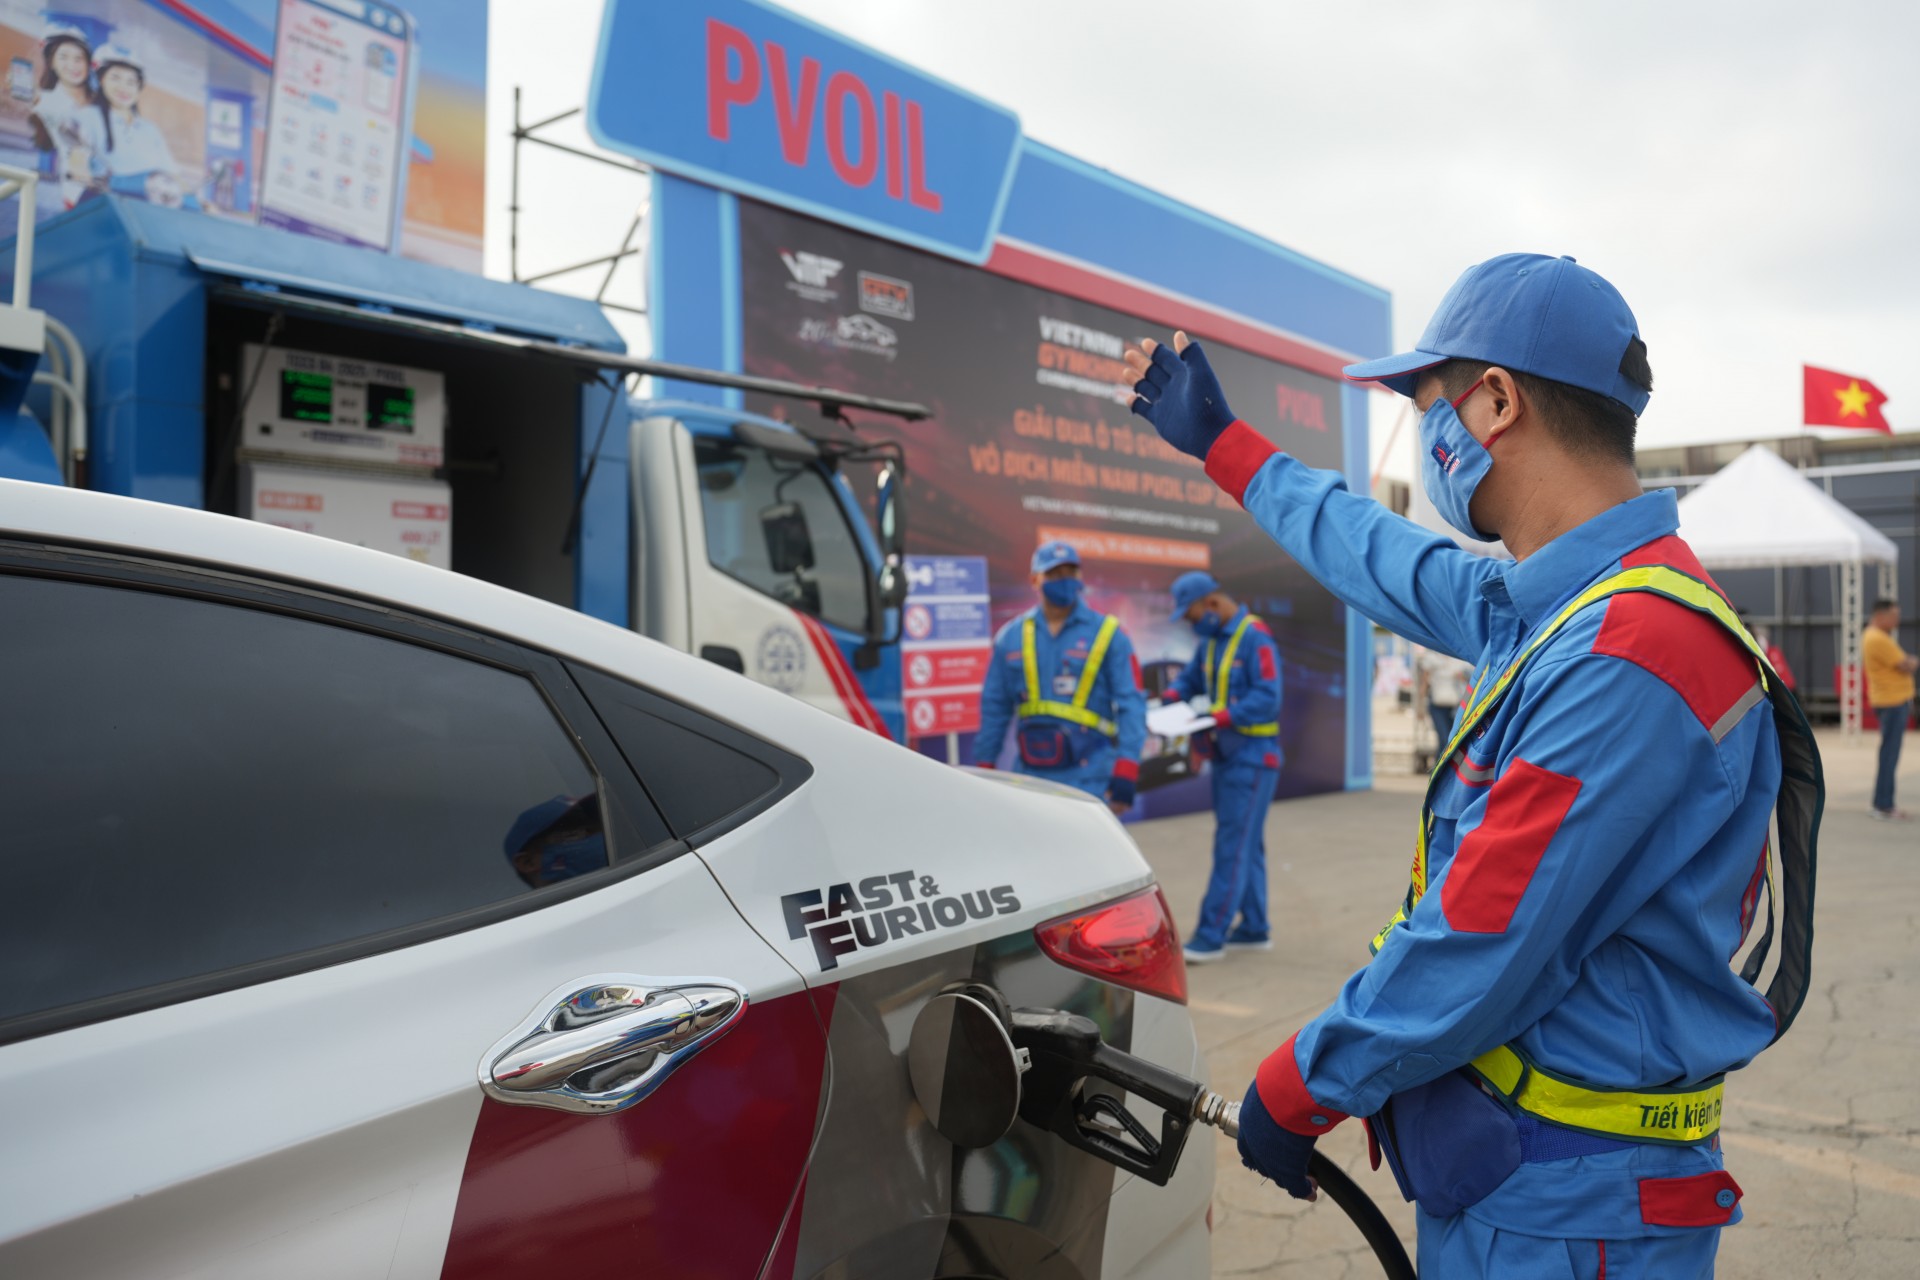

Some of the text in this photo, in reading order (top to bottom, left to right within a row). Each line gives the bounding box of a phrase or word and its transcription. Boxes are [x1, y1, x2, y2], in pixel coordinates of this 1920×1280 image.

[706, 16, 943, 214] PVOIL
[1276, 384, 1329, 433] PVOIL
[780, 870, 941, 941] FAST &
[809, 885, 1022, 972] FURIOUS
[1640, 1102, 1678, 1129] Tiết
[1684, 1101, 1713, 1132] kiệm
